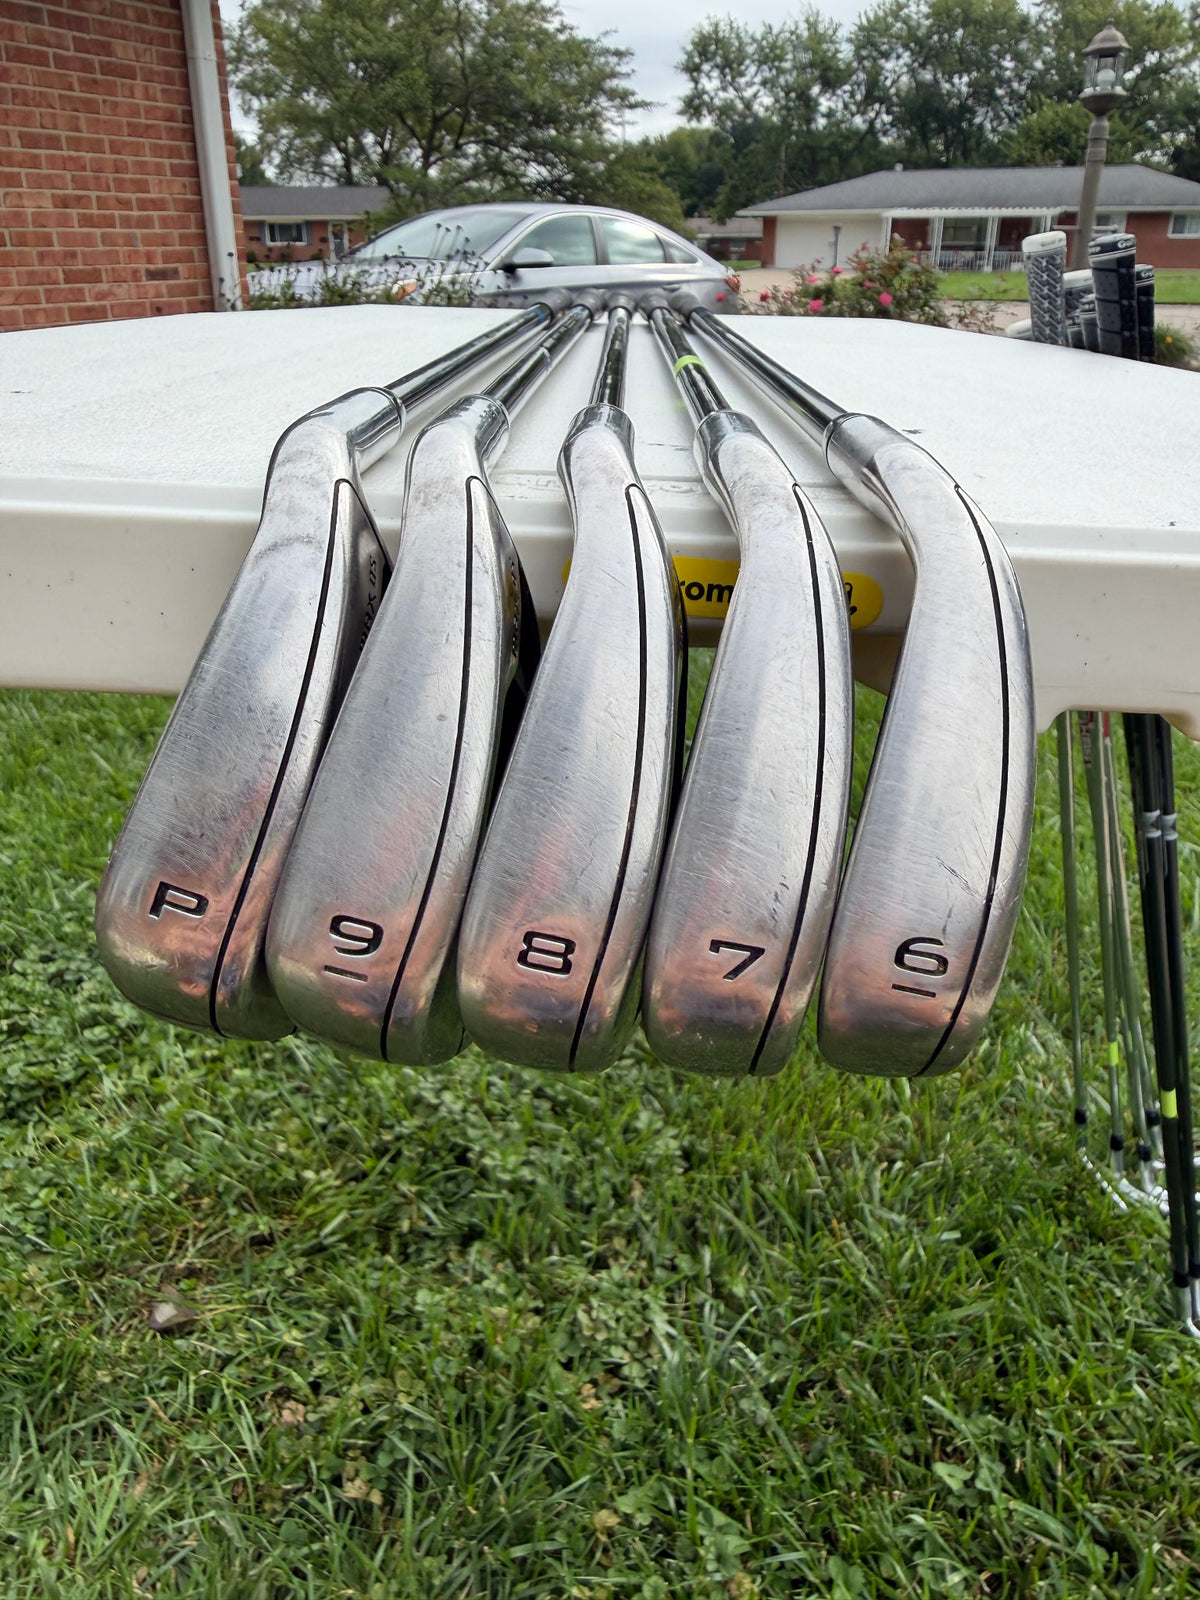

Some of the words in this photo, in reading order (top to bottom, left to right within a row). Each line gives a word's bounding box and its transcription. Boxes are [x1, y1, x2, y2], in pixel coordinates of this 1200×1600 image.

[148, 880, 210, 920] P
[328, 914, 385, 958] 9
[516, 930, 578, 976] 8
[893, 936, 950, 977] 6
[708, 938, 766, 982] 7
